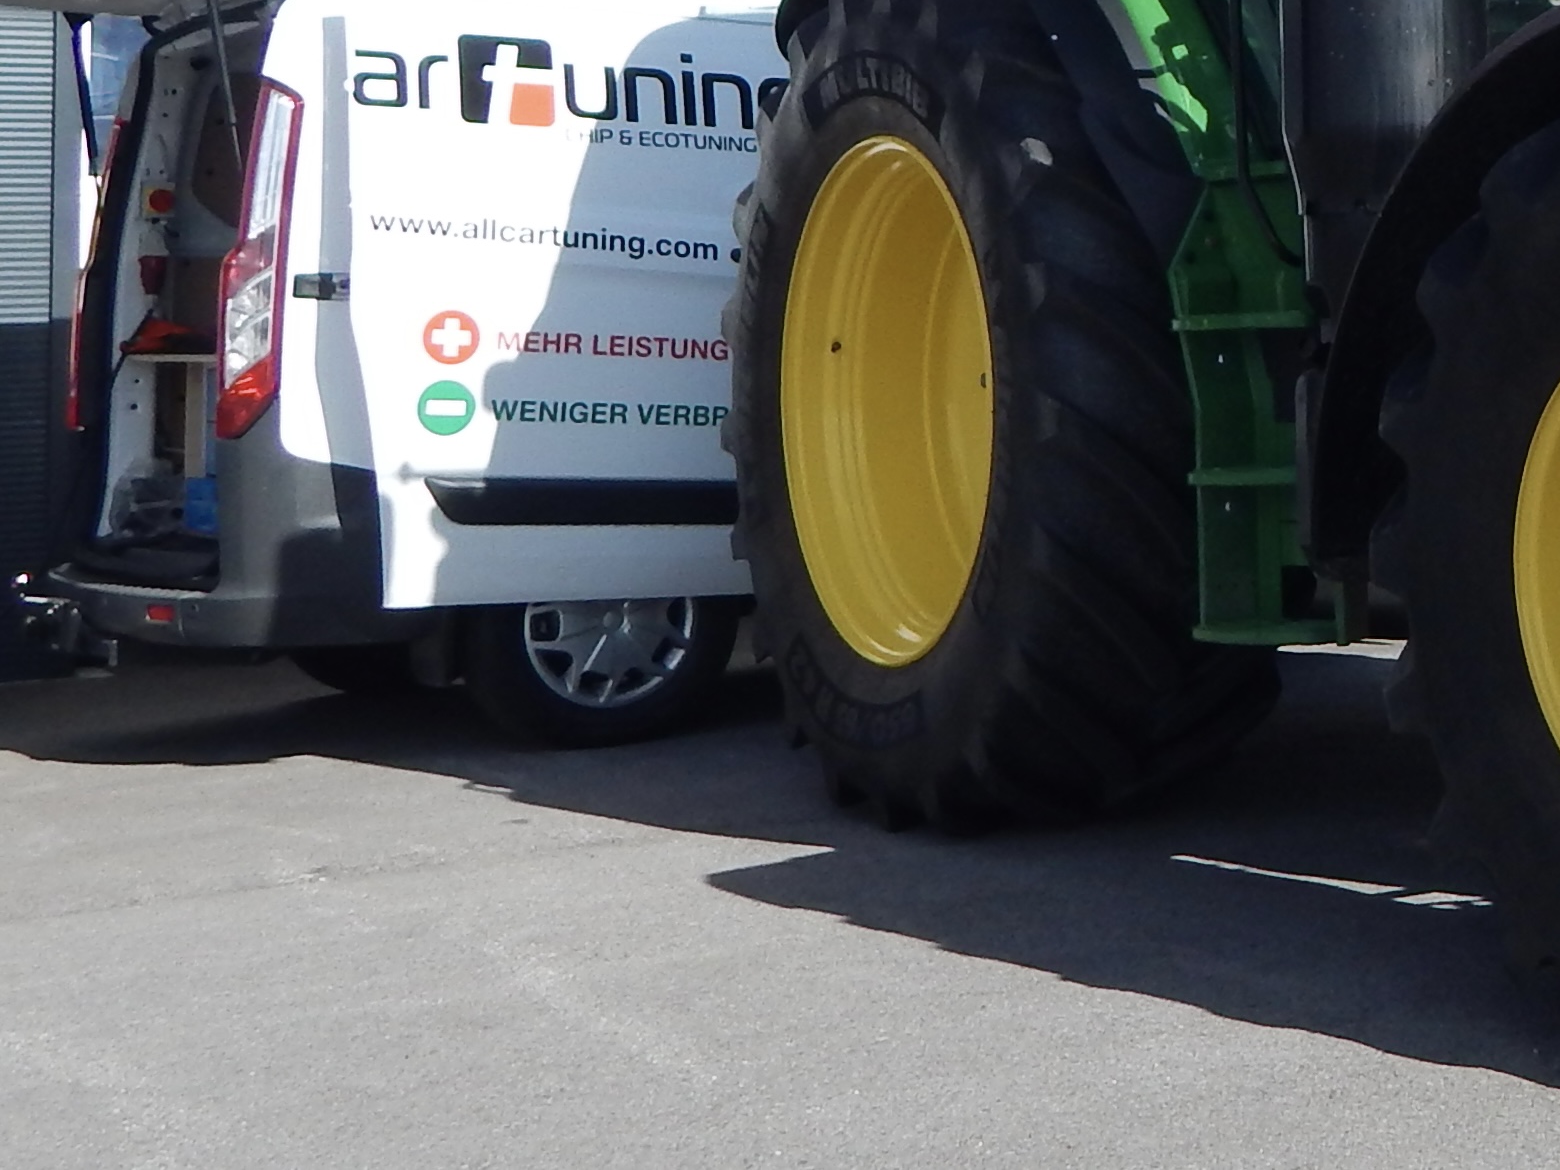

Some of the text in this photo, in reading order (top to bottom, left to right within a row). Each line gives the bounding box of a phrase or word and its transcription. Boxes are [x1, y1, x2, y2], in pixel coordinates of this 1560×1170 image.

[619, 129, 632, 146] &
[639, 131, 758, 153] ECOTUNING
[370, 213, 719, 261] www.allcartuning.com
[497, 331, 729, 362] MEHR LEISTUNG
[491, 399, 628, 425] WENIGER
